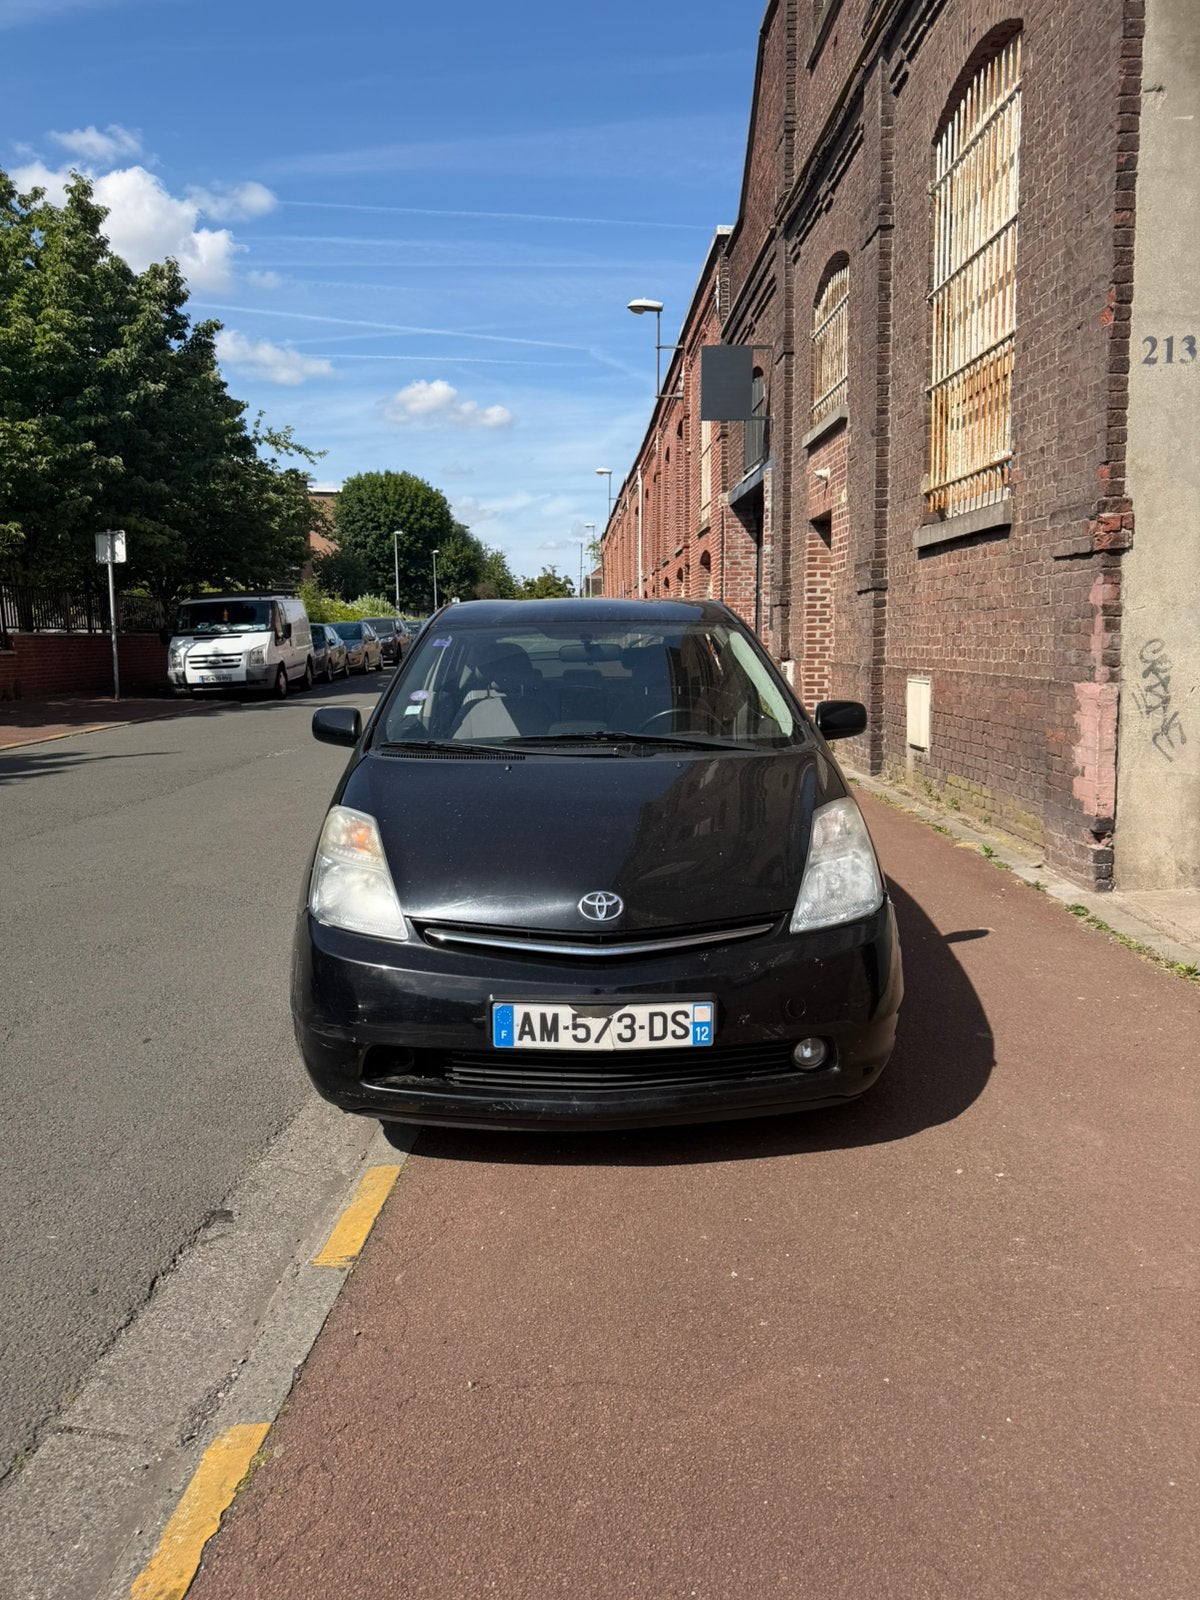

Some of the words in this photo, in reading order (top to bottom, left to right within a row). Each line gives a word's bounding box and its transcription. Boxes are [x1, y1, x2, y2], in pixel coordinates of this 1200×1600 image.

[1142, 335, 1198, 366] 213
[501, 1030, 508, 1040] F
[695, 1026, 709, 1041] 12
